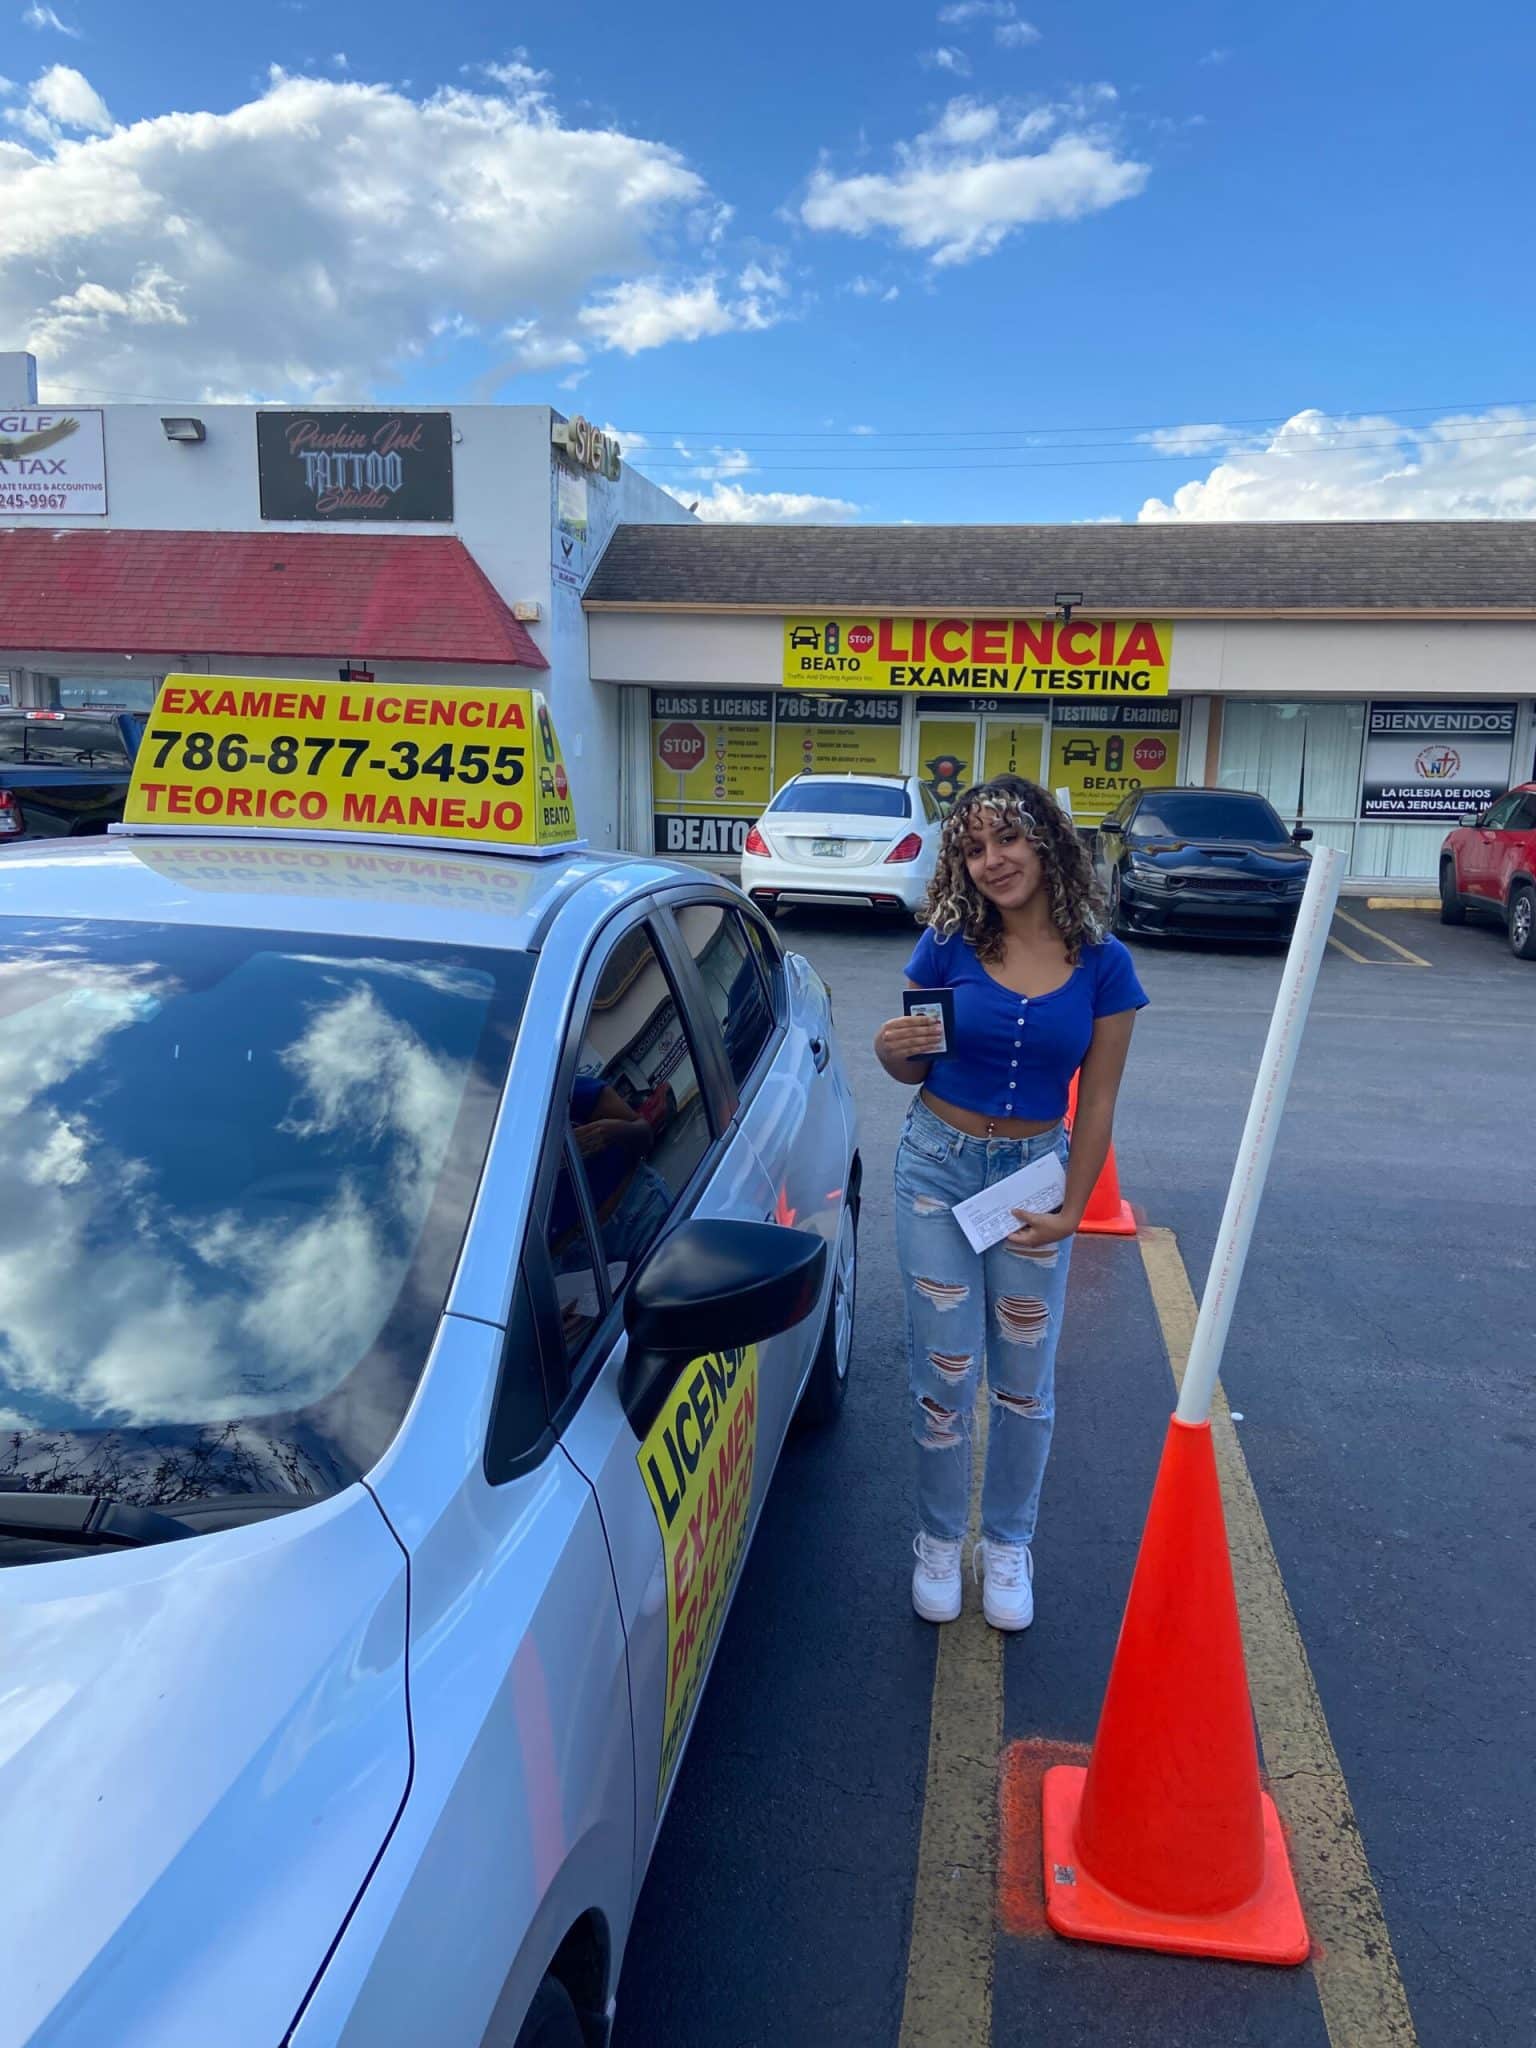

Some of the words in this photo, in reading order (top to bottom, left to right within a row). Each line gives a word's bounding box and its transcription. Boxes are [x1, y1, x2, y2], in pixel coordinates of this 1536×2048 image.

[14, 459, 67, 475] TAX
[298, 450, 404, 497] TATTOO
[315, 485, 390, 513] Studio
[848, 635, 873, 644] STOP
[878, 619, 1165, 667] LICENCIA
[801, 657, 860, 671] BEATO
[890, 667, 1009, 688] EXAMEN
[1031, 669, 1151, 691] TESTING
[162, 689, 327, 720] EXAMEN
[339, 696, 526, 729] LICENCIA
[656, 697, 697, 714] CLASS
[702, 698, 710, 715] E
[714, 699, 768, 716] LICENSE
[778, 698, 898, 719] 786-877-3455
[969, 700, 998, 711] 120
[1058, 706, 1108, 722] TESTING
[1123, 707, 1178, 724] Examen
[1371, 714, 1513, 730] BIENVENIDOS
[663, 739, 701, 753] STOP
[1135, 749, 1164, 760] STOP
[150, 730, 525, 786] 786-877-3455
[1083, 776, 1142, 791] BEATO
[1382, 788, 1396, 797] LA
[1399, 788, 1442, 798] IGLESIA
[1445, 789, 1460, 798] DE
[1463, 789, 1491, 798] DIOS
[140, 784, 328, 820] TEORICO
[342, 792, 523, 831] MANEJO
[1366, 800, 1406, 810] NUEVA
[544, 807, 570, 826] BEATO
[667, 818, 749, 851] BEATO
[674, 1368, 756, 1625] EXAMEN
